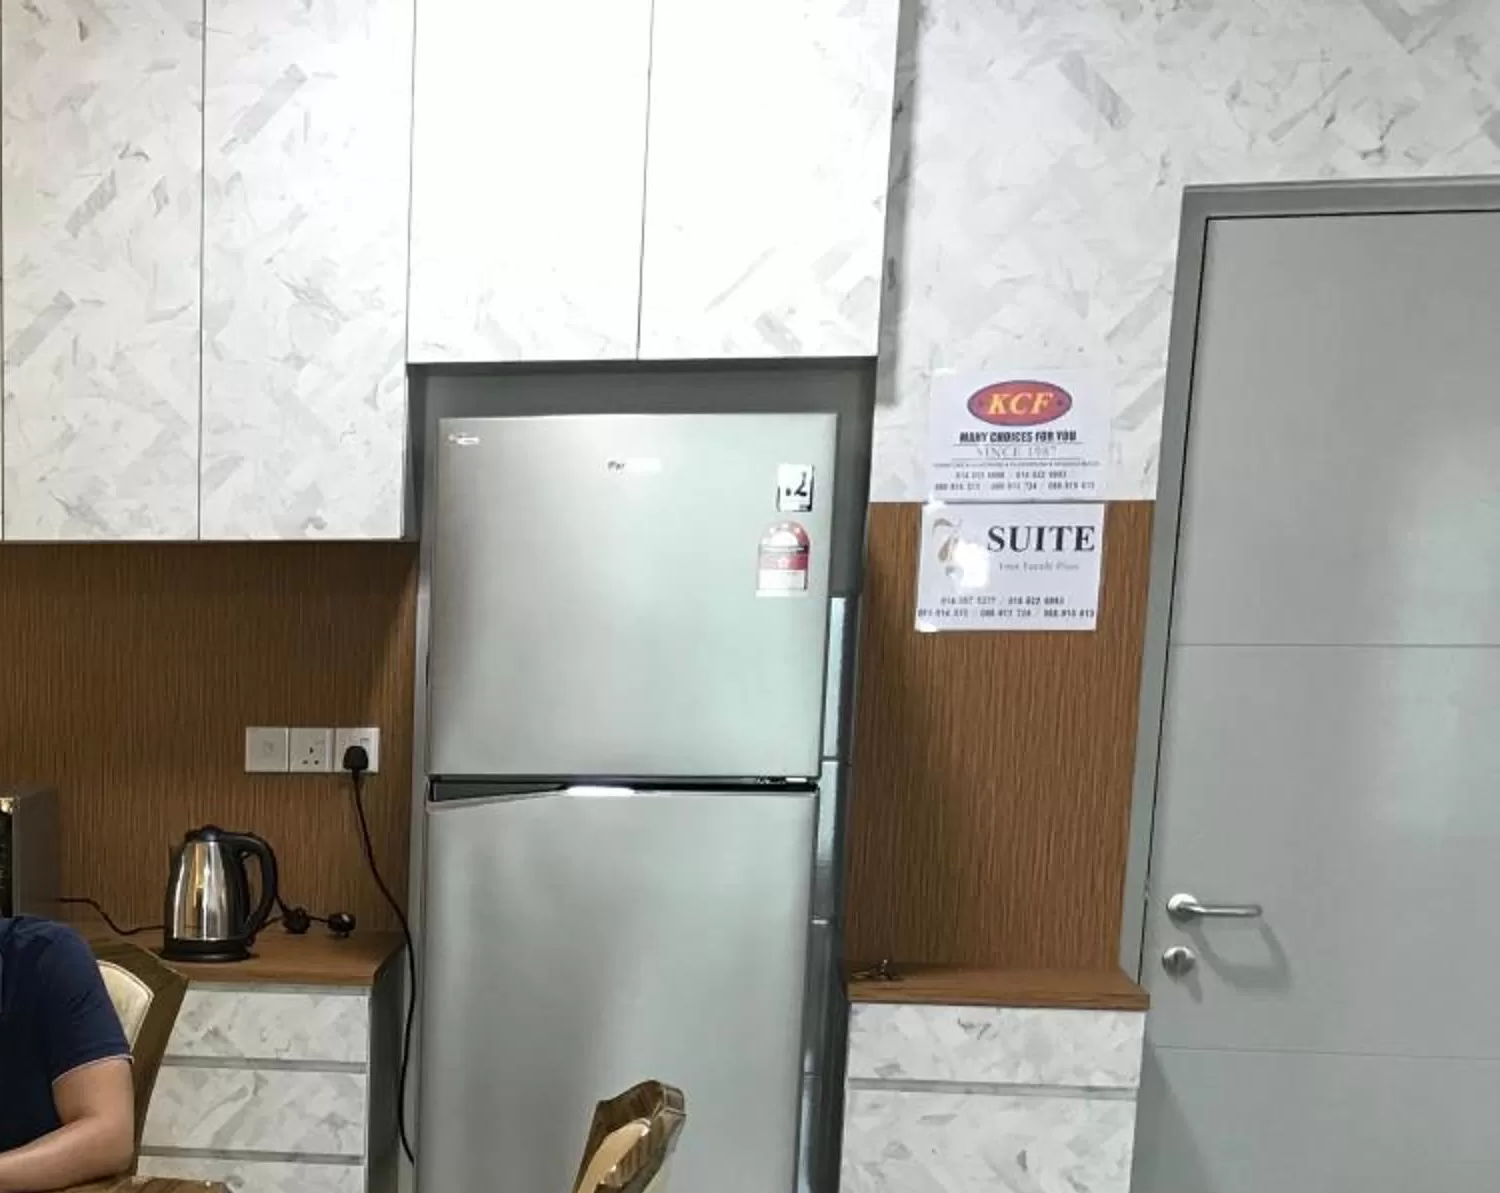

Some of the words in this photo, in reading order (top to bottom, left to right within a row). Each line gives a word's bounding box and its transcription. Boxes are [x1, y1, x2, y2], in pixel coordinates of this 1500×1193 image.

[987, 391, 1055, 416] KCF
[959, 431, 988, 443] MANY
[990, 431, 1033, 443] CHOICES
[1035, 431, 1054, 442] FOR
[1056, 430, 1077, 441] YOU
[976, 446, 1019, 457] SINCE
[987, 525, 1096, 553] SUITE
